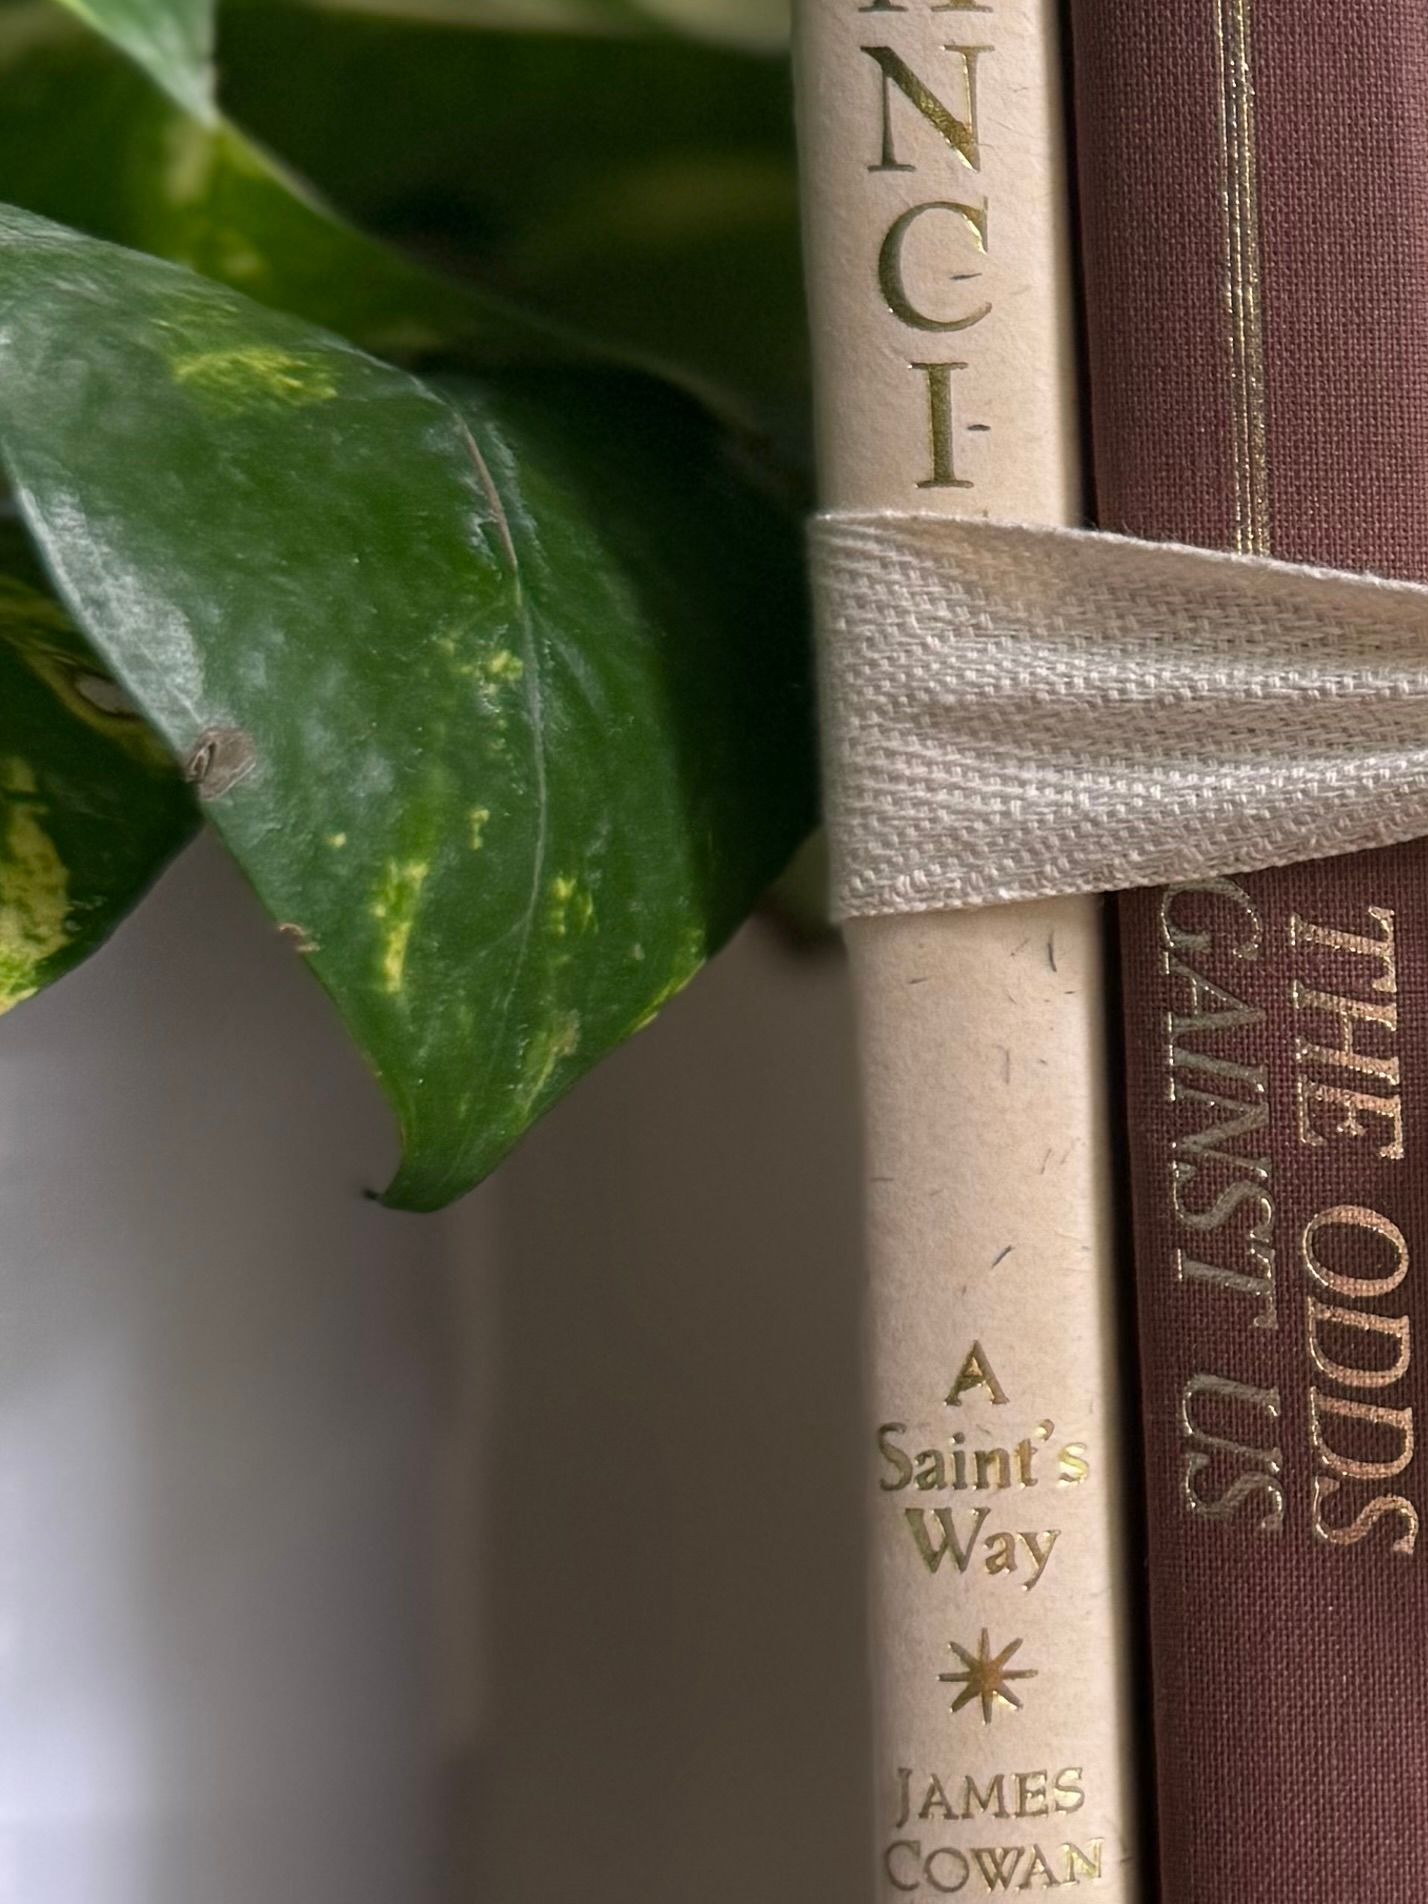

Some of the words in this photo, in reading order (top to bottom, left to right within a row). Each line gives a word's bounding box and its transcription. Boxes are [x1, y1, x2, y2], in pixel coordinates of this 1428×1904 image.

[1290, 906, 1408, 1161] THE
[1160, 874, 1280, 1332] GAINST
[944, 1339, 1010, 1407] A
[1300, 1202, 1420, 1556] ODDS
[877, 1418, 1090, 1492] Saint's
[1180, 1372, 1285, 1533] US
[904, 1506, 1062, 1592] Way
[895, 1766, 1086, 1830] JAMES
[882, 1836, 1106, 1894] COWAN
